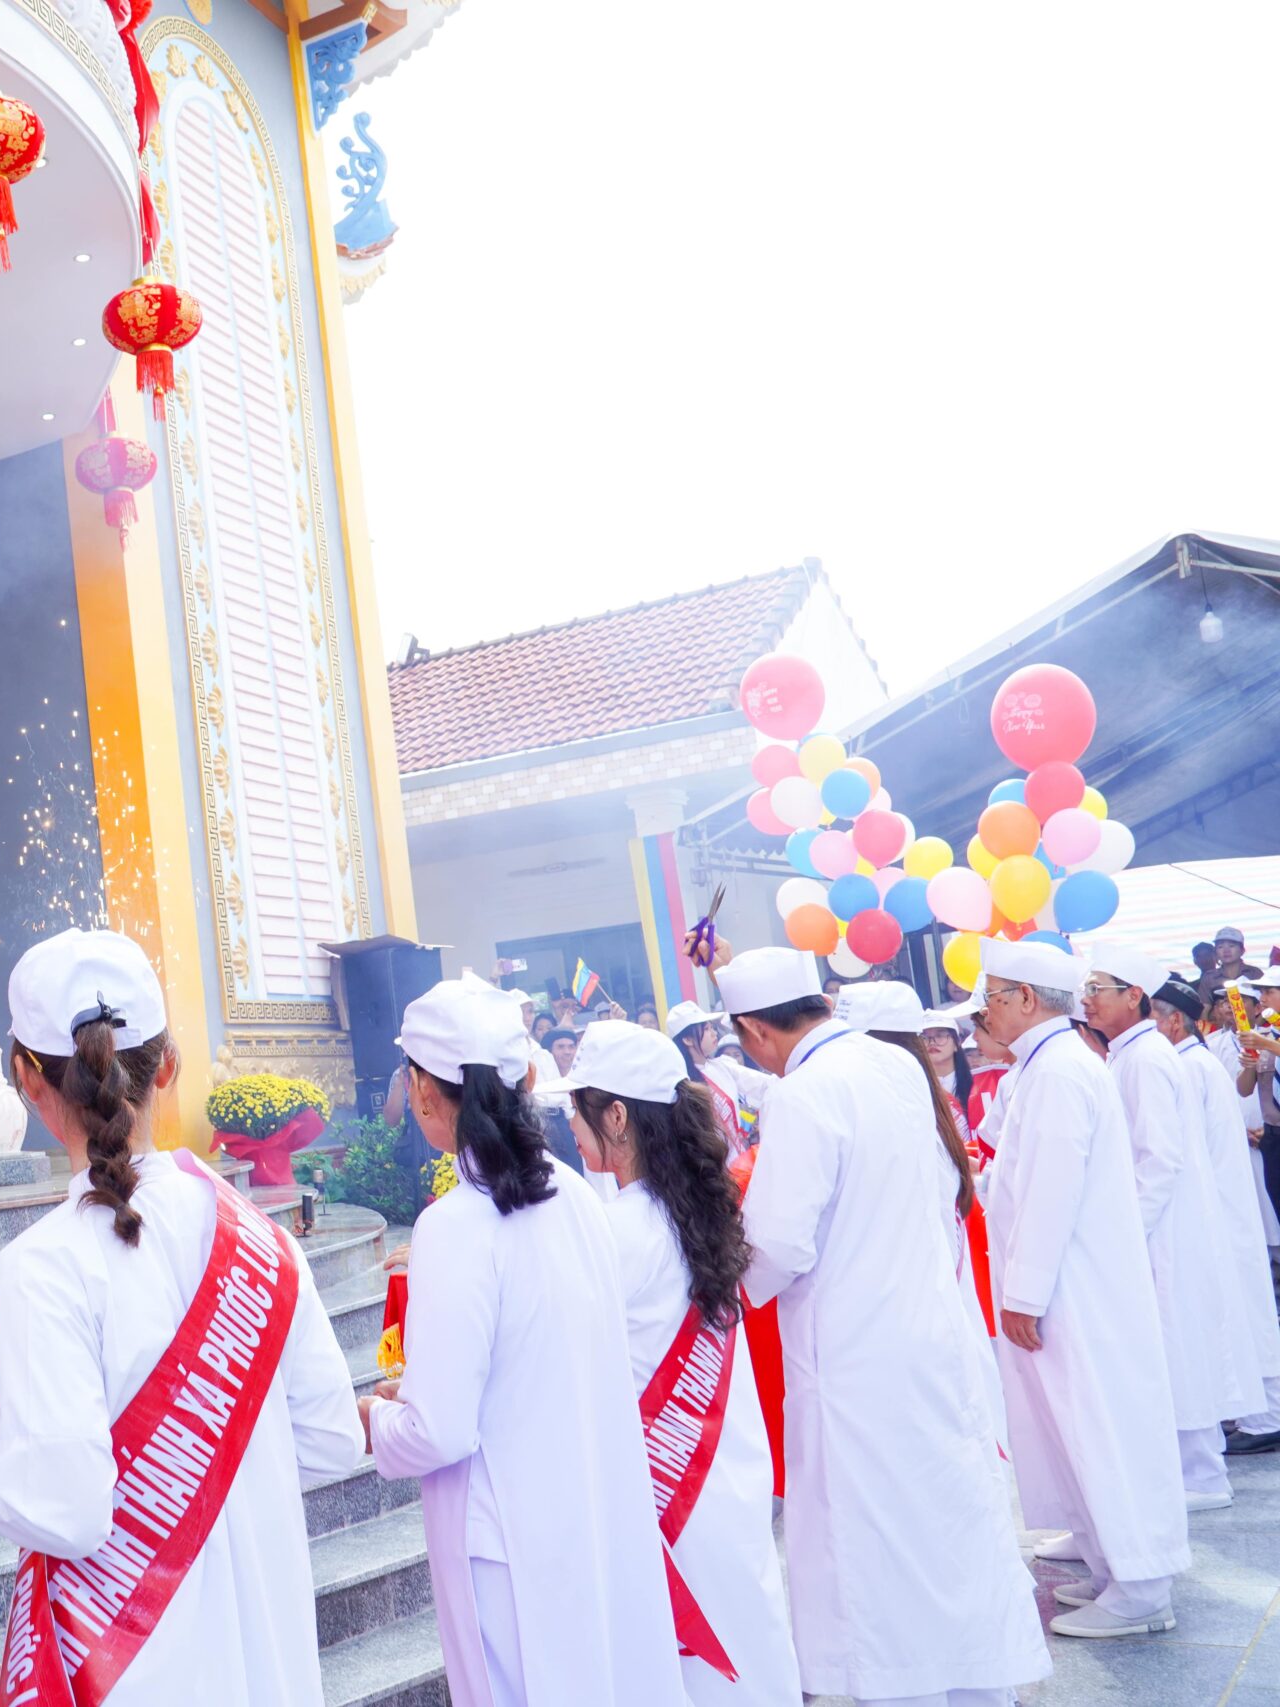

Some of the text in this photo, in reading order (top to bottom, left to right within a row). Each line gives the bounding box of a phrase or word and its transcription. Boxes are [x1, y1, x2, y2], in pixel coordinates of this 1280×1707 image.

[202, 1265, 273, 1391] PHƯỚC
[671, 1332, 724, 1416] THÁNH
[173, 1362, 237, 1441] XÁ
[113, 1413, 216, 1541] THÁNH
